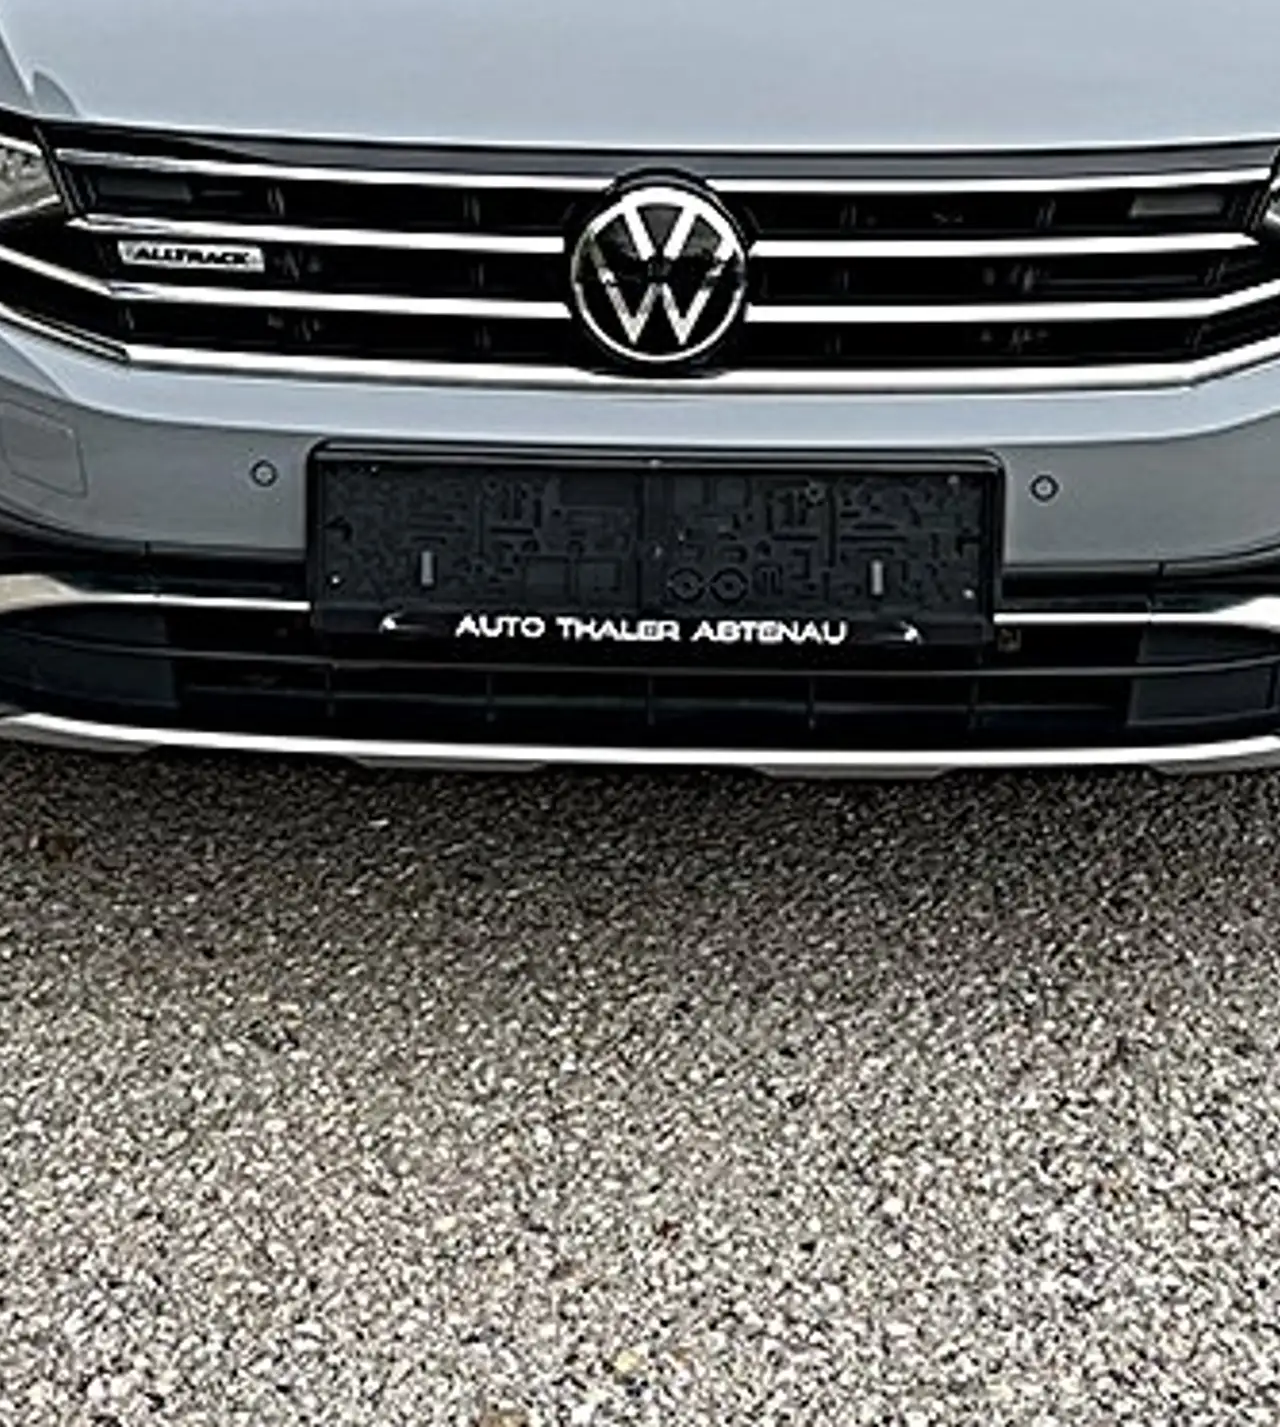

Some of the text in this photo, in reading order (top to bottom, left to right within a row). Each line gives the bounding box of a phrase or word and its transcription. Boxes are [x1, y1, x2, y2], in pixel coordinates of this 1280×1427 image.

[133, 246, 250, 265] ALLTRACK
[455, 614, 848, 645] AUTO THALER ABTENAU
